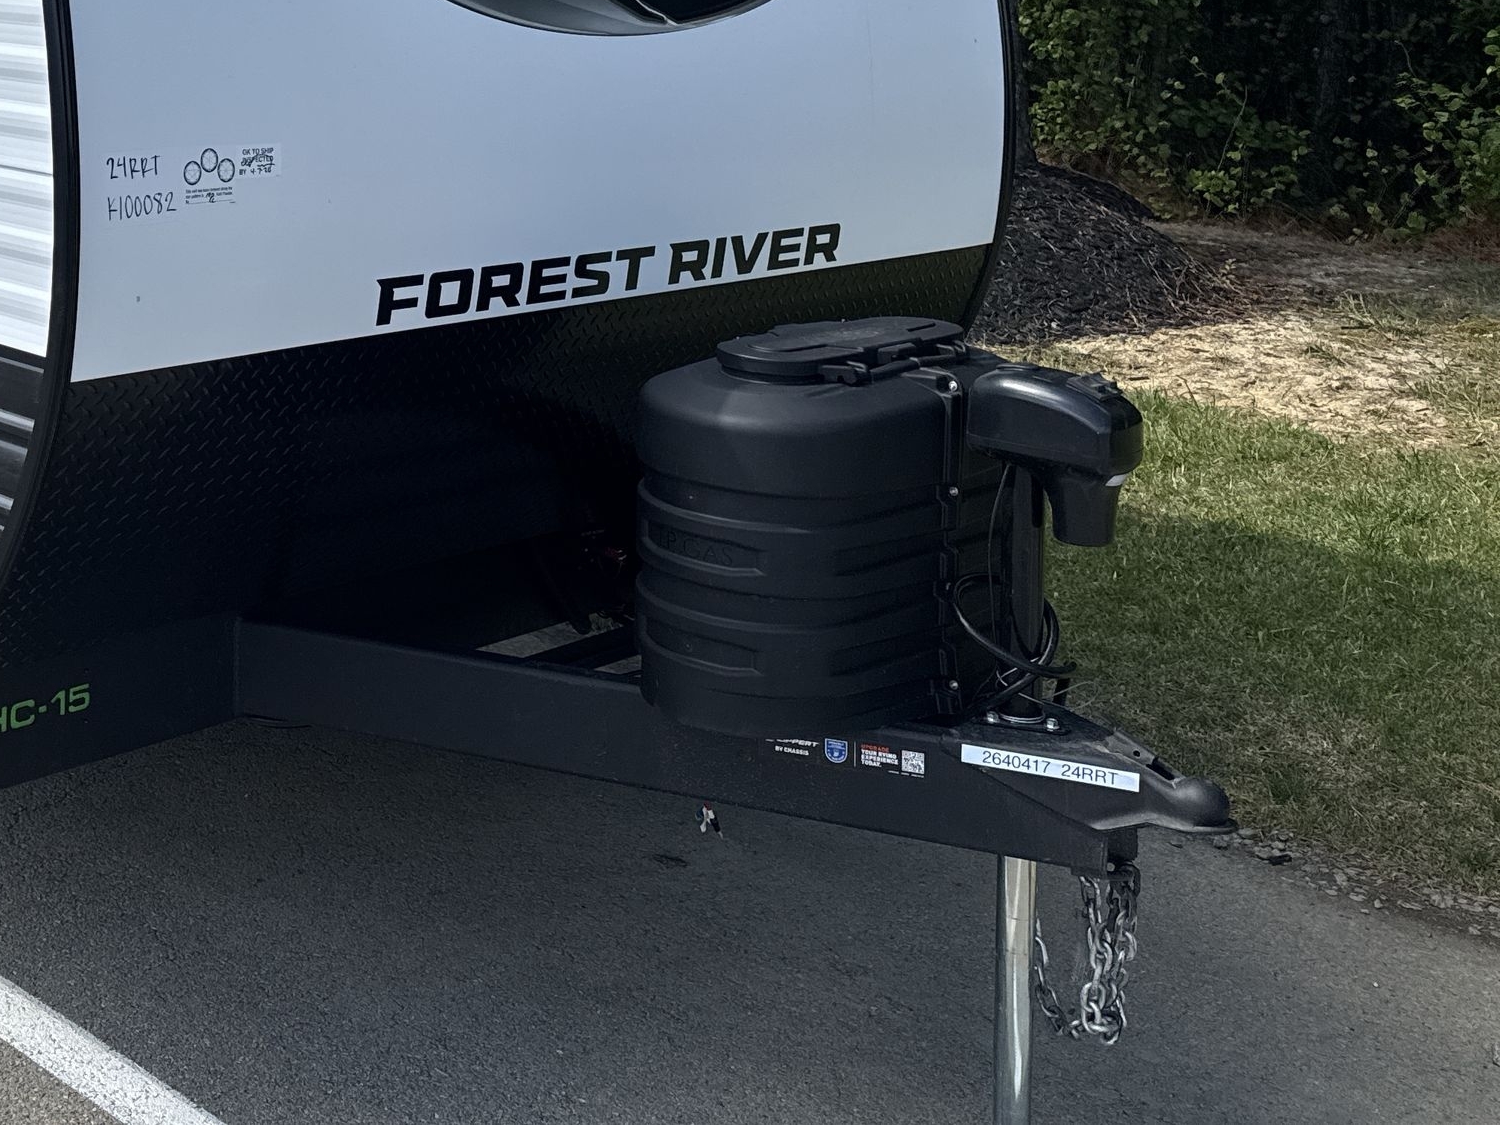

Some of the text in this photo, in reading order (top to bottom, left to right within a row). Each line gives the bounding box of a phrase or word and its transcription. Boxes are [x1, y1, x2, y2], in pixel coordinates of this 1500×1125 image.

[106, 155, 161, 180] 24RRT
[107, 191, 178, 221] K100082
[376, 222, 842, 326] FOREST RIVER
[683, 538, 733, 566] GAS
[860, 754, 899, 765] EXPERIENCE
[982, 750, 1119, 785] 2640417 24RRT
